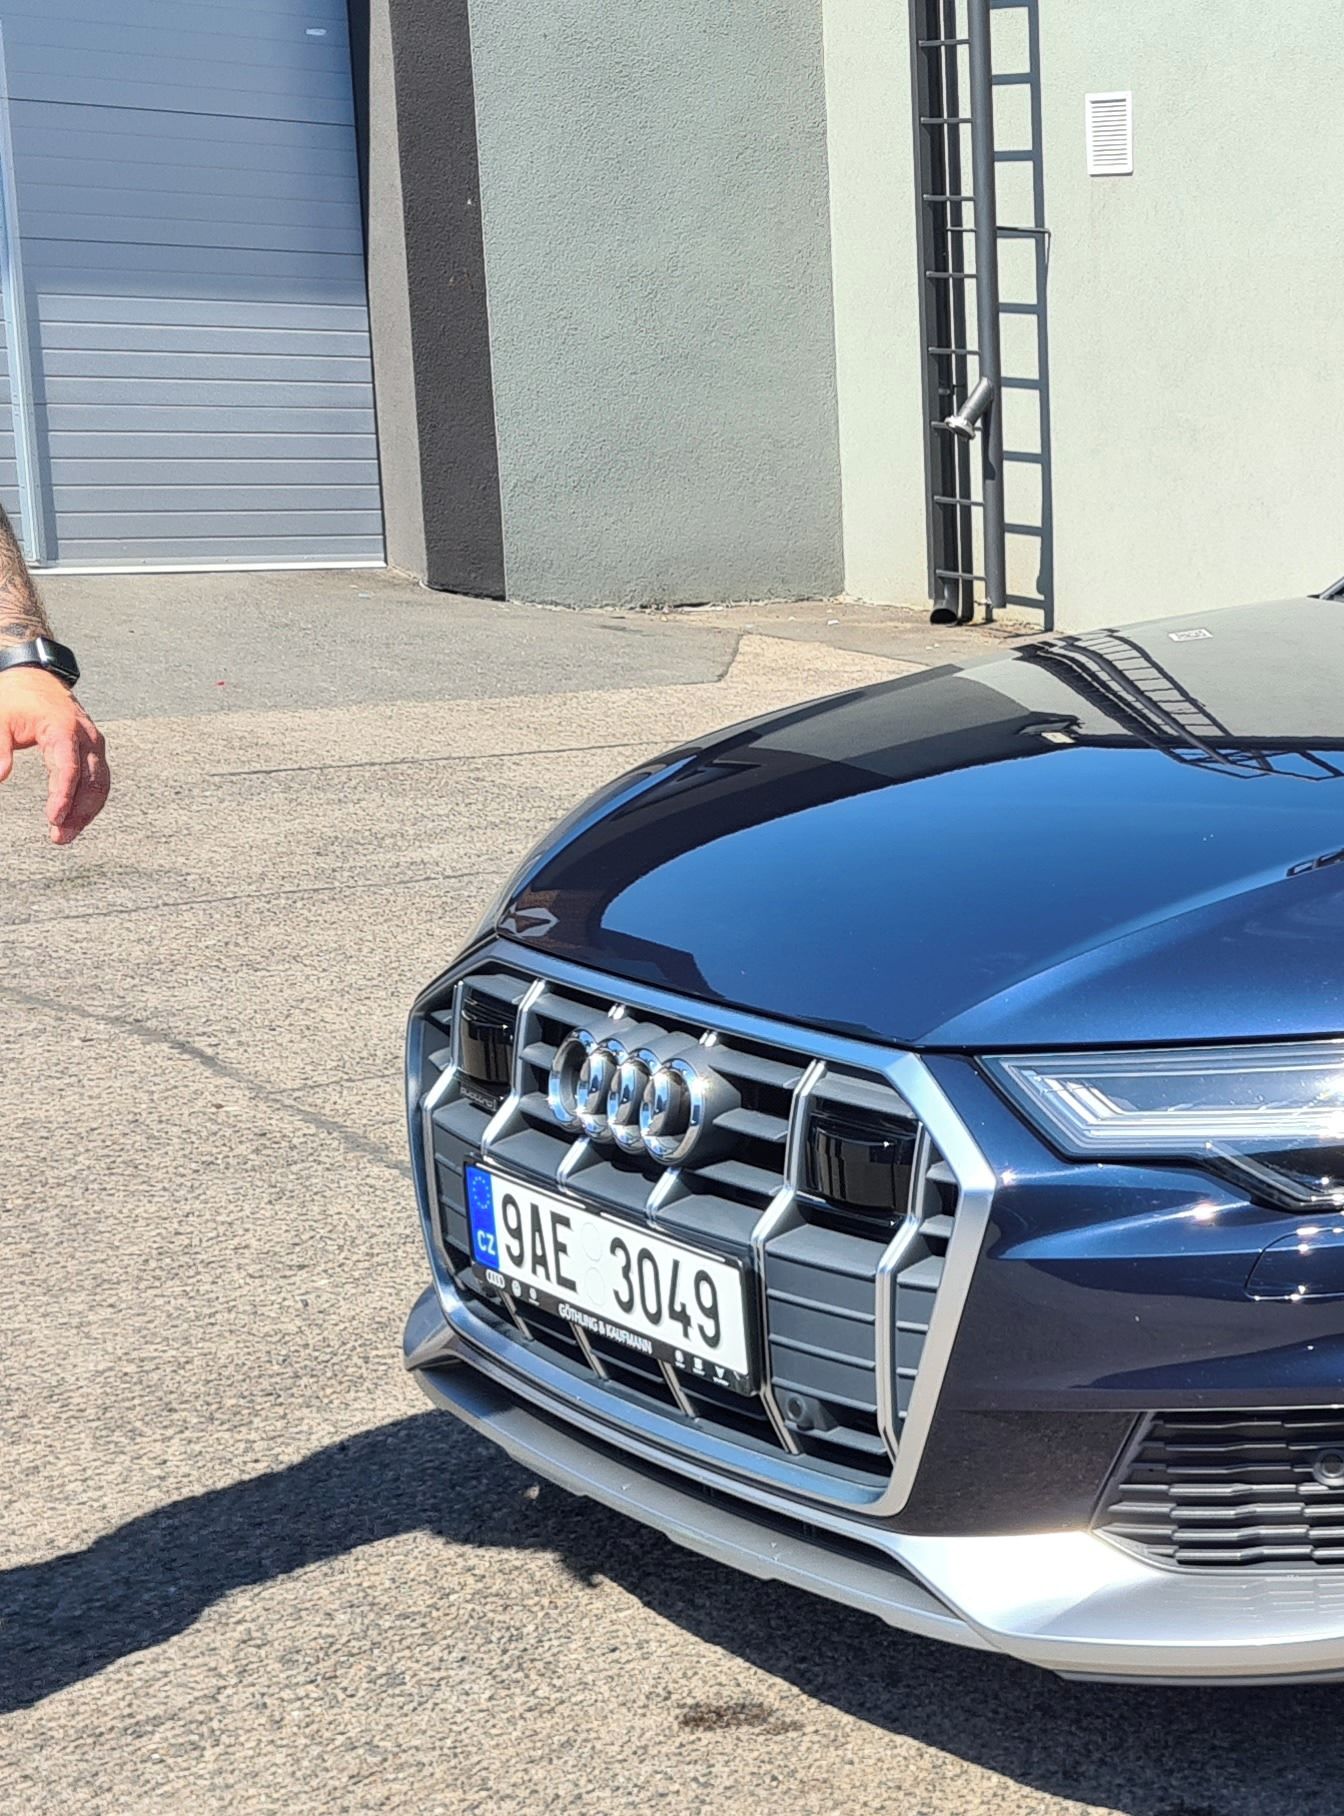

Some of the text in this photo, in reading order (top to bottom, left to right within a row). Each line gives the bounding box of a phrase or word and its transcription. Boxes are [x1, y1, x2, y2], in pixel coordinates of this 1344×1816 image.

[477, 1230, 496, 1256] CZ
[501, 1193, 721, 1349] 9AE 3049
[606, 1324, 653, 1355] KAUFMANN
